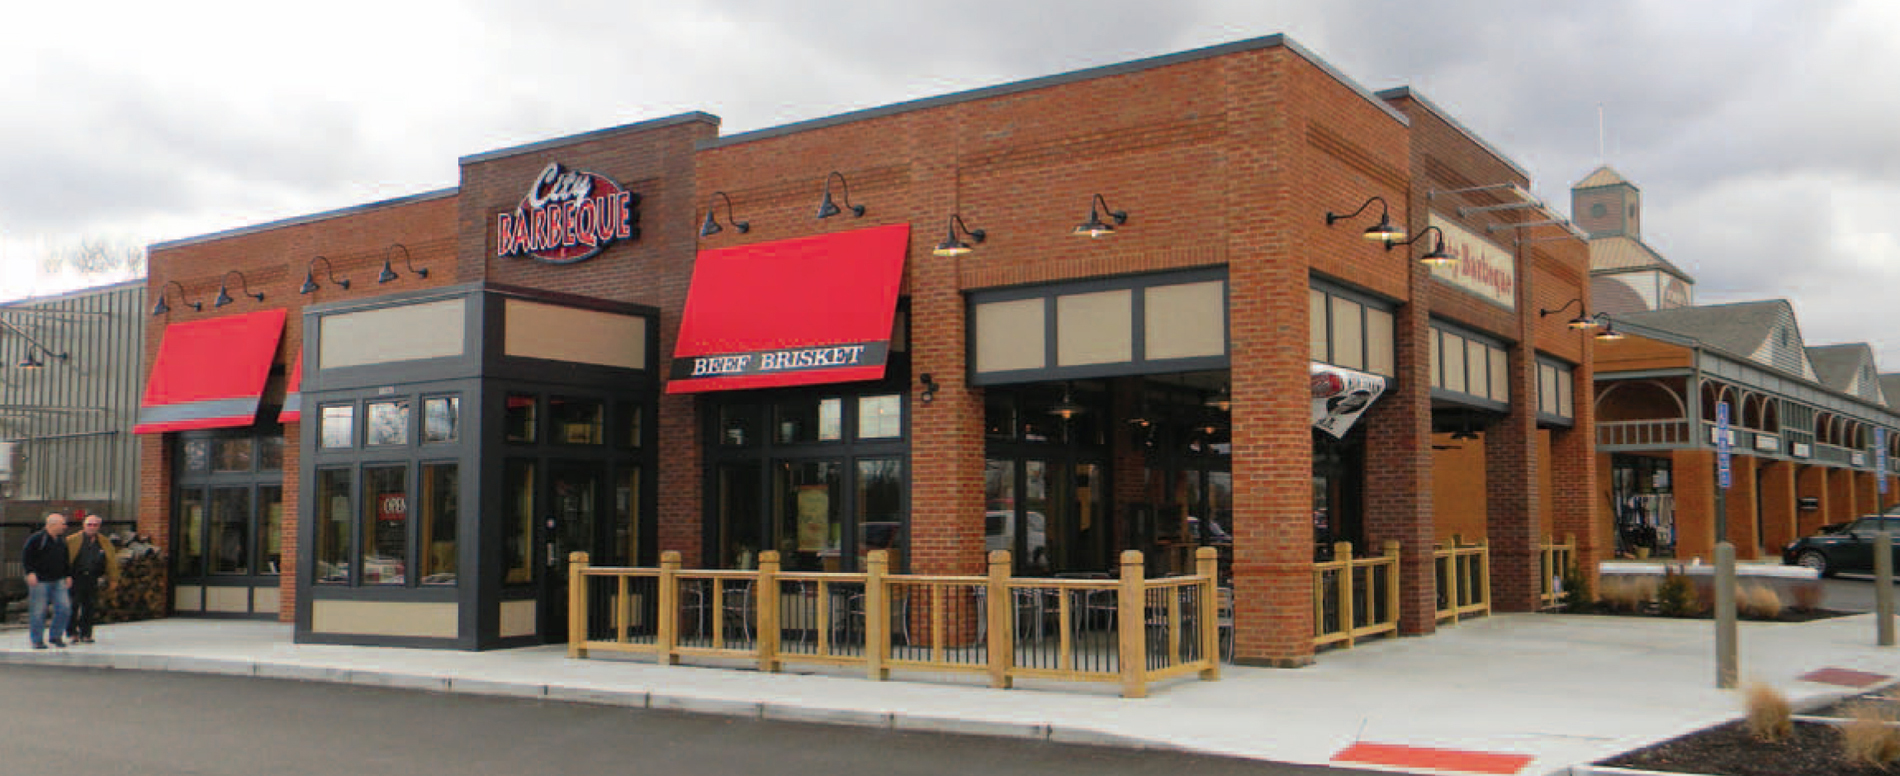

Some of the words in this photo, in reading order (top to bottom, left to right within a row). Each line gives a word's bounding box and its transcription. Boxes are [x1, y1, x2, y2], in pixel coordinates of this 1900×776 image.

[530, 162, 591, 207] City
[497, 191, 631, 258] BARBEQUE
[1461, 243, 1512, 299] Barbeque
[691, 354, 752, 376] BEEF
[759, 345, 865, 370] BRISKET
